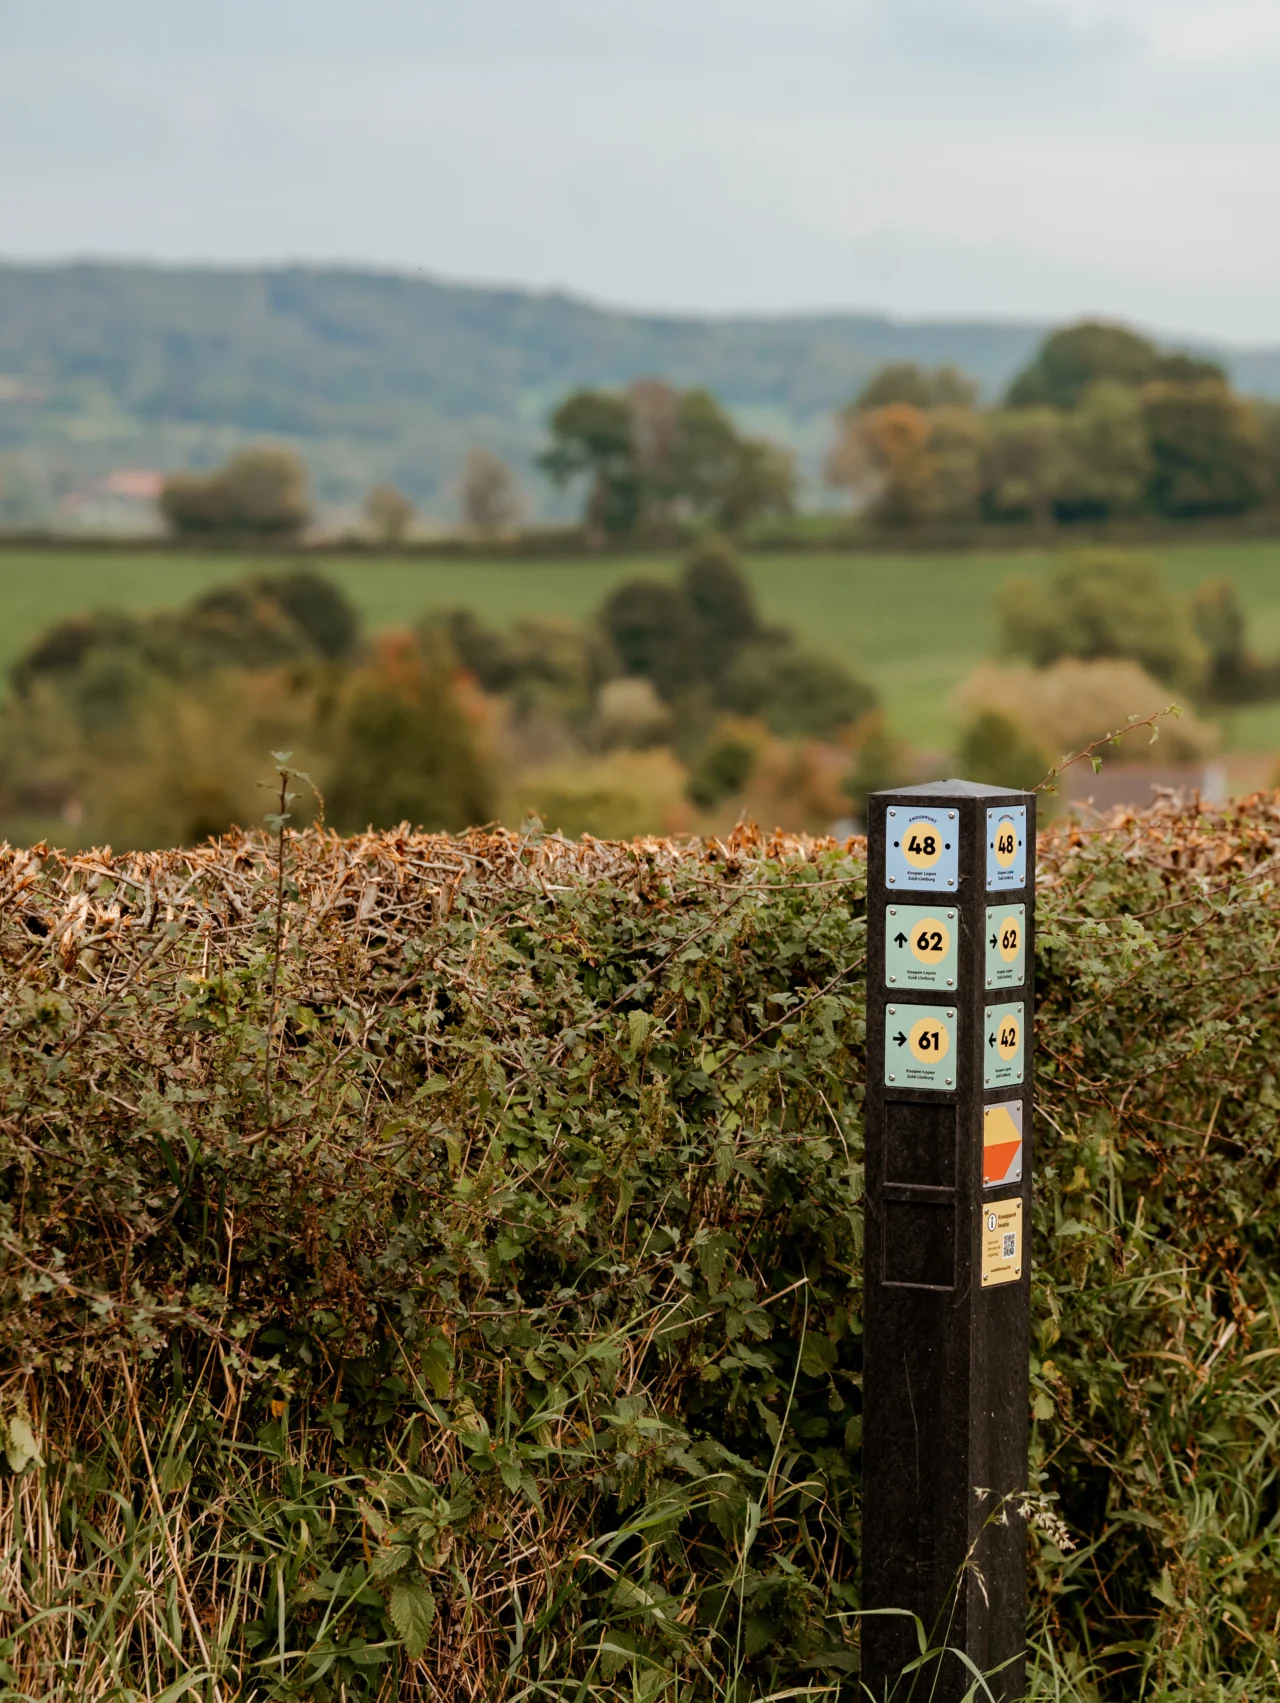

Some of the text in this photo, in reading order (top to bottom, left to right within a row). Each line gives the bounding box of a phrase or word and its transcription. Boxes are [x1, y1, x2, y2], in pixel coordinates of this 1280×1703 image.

[909, 815, 937, 823] KNOOPPUNT
[908, 836, 936, 855] 48
[998, 835, 1013, 854] 48
[917, 932, 942, 951] 62
[1003, 930, 1016, 949] 62
[918, 1032, 939, 1050] 61
[1001, 1028, 1015, 1047] 42
